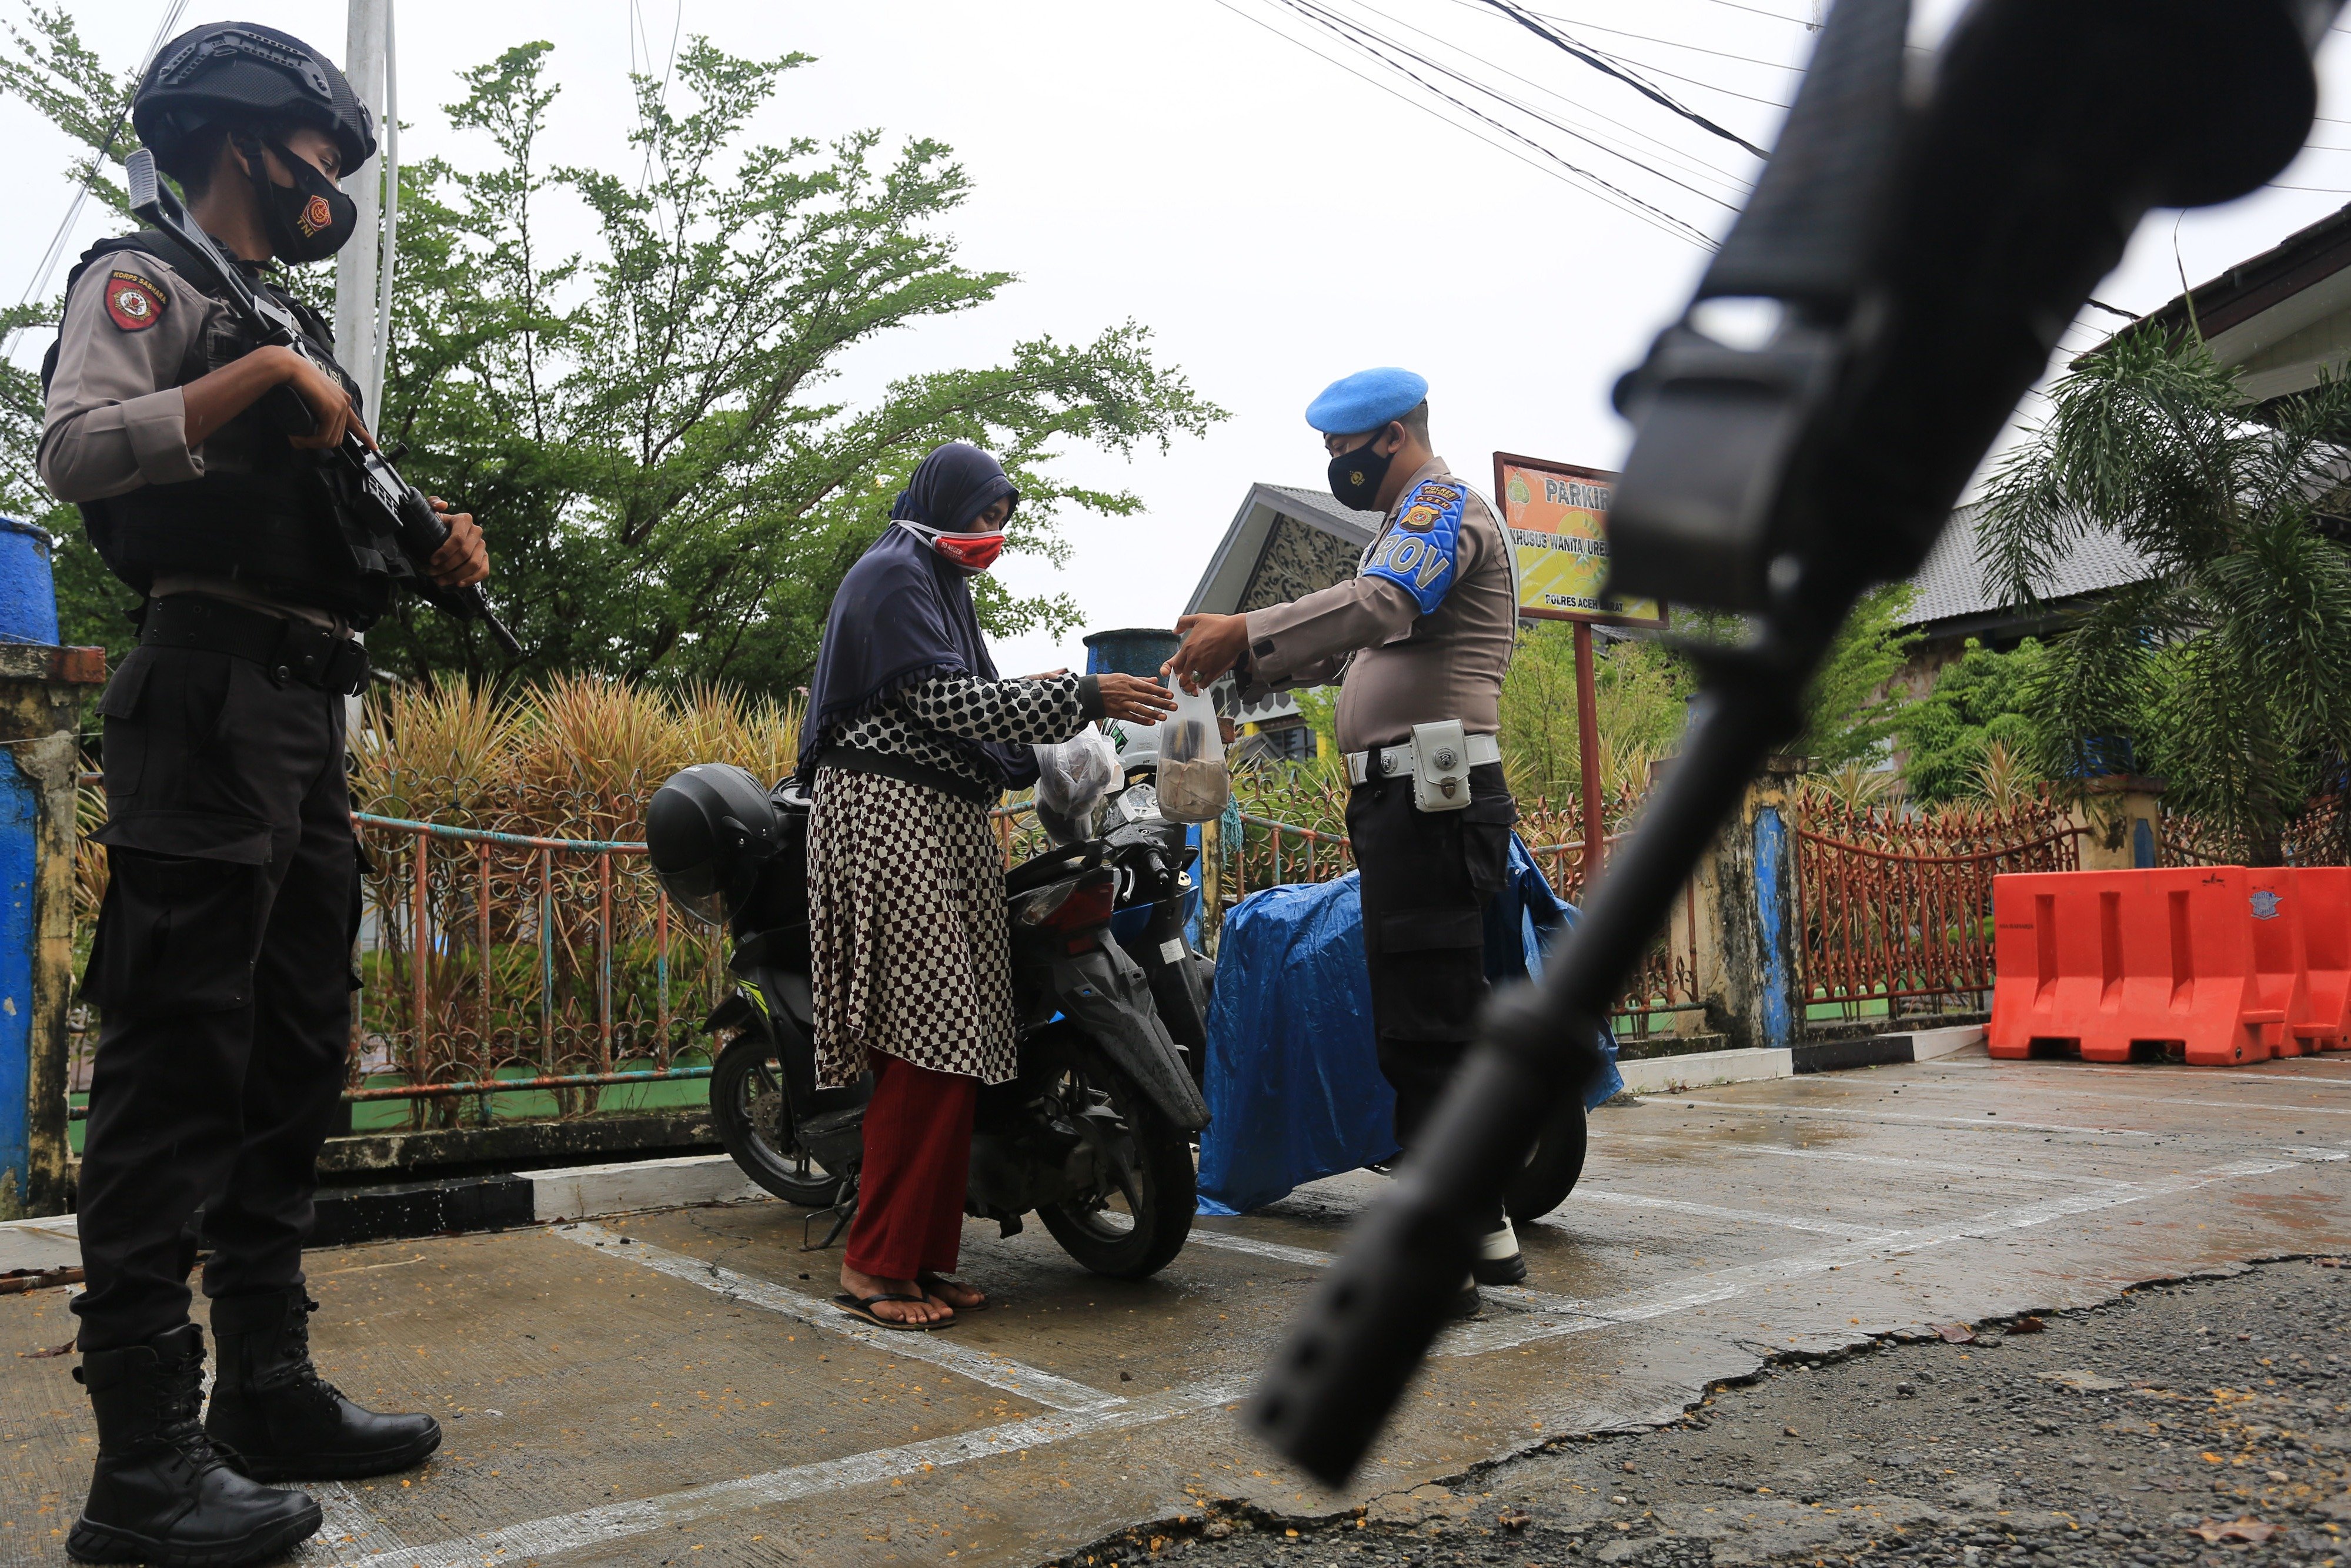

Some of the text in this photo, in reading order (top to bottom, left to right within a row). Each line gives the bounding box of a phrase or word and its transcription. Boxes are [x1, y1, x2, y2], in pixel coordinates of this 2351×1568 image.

[297, 216, 314, 238] TNI
[113, 271, 168, 305] KORPS SABHARA
[1424, 486, 1456, 497] POLRES
[1545, 478, 1611, 512] PARKIR
[1418, 496, 1448, 508] ACEH
[1509, 529, 1548, 549] KHUSUS
[1545, 594, 1577, 607] POLRES
[1578, 597, 1598, 610] ACEH
